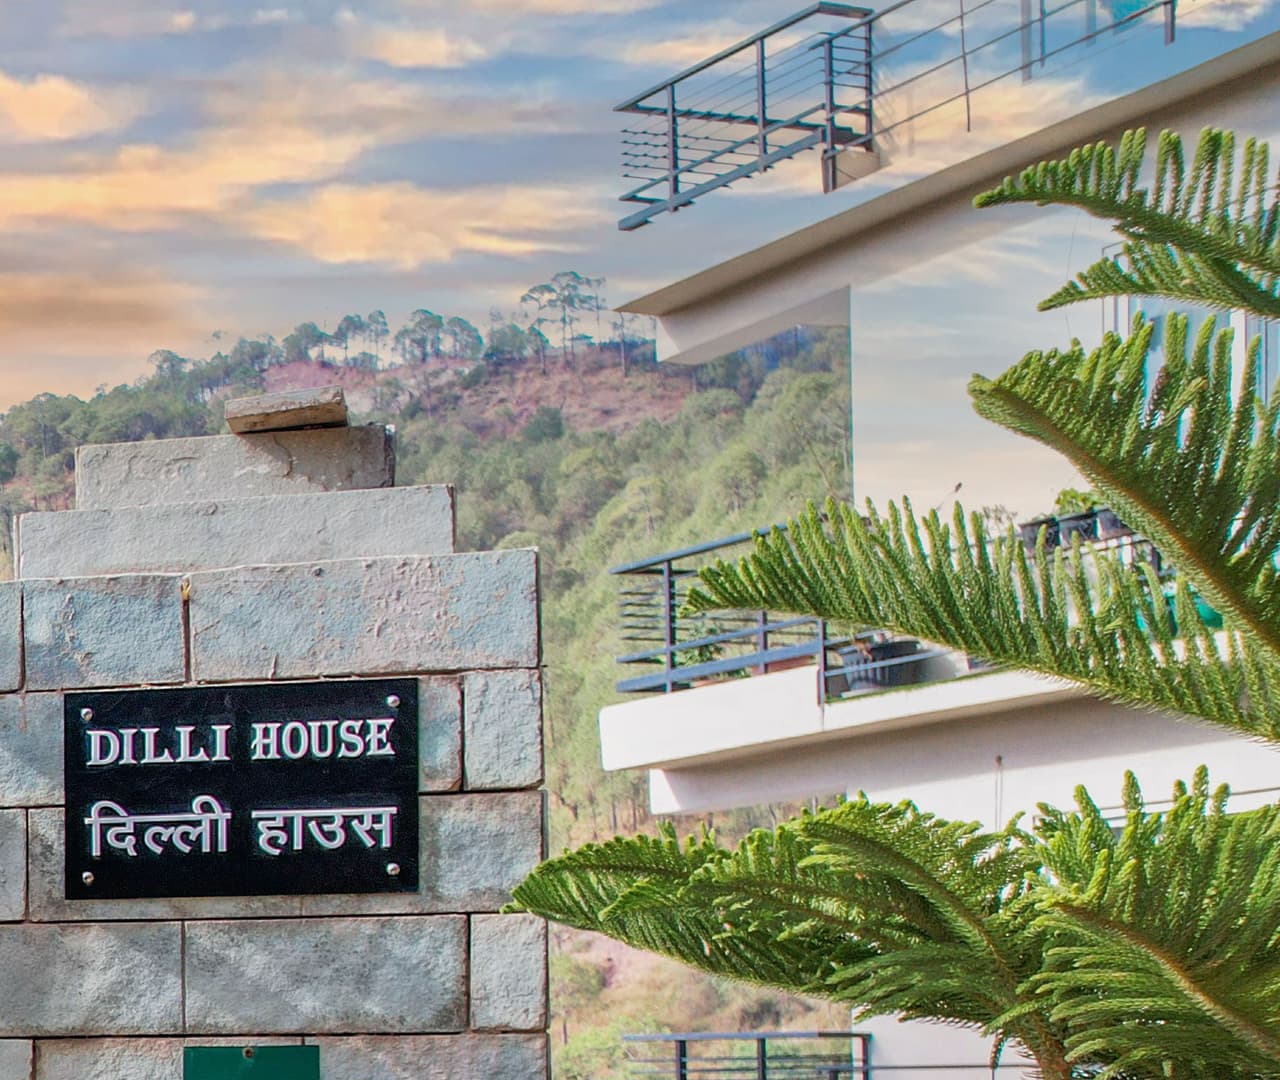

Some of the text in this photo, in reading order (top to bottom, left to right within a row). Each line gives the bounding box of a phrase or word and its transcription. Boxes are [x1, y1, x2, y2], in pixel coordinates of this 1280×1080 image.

[85, 718, 396, 766] DILLI HOUSE
[84, 795, 398, 857] दिल्ली हाउस
